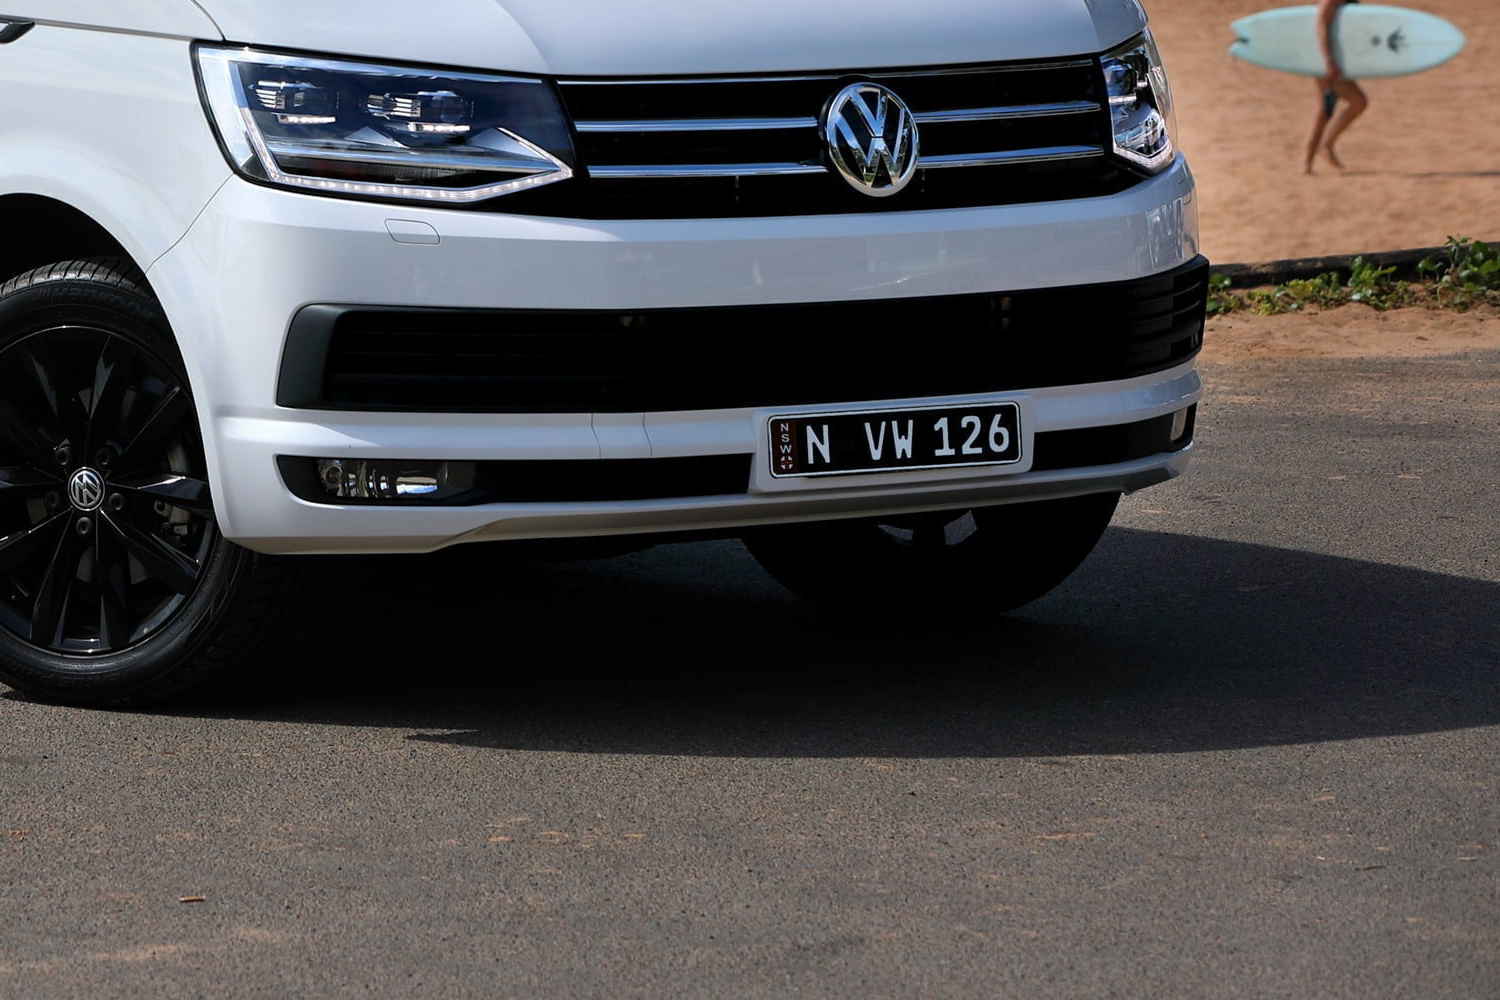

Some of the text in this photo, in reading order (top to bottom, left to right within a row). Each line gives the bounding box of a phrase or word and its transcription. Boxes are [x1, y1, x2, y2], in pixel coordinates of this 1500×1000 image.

[828, 83, 917, 195] VW
[780, 422, 792, 454] NSW
[806, 414, 1010, 464] N VW 126
